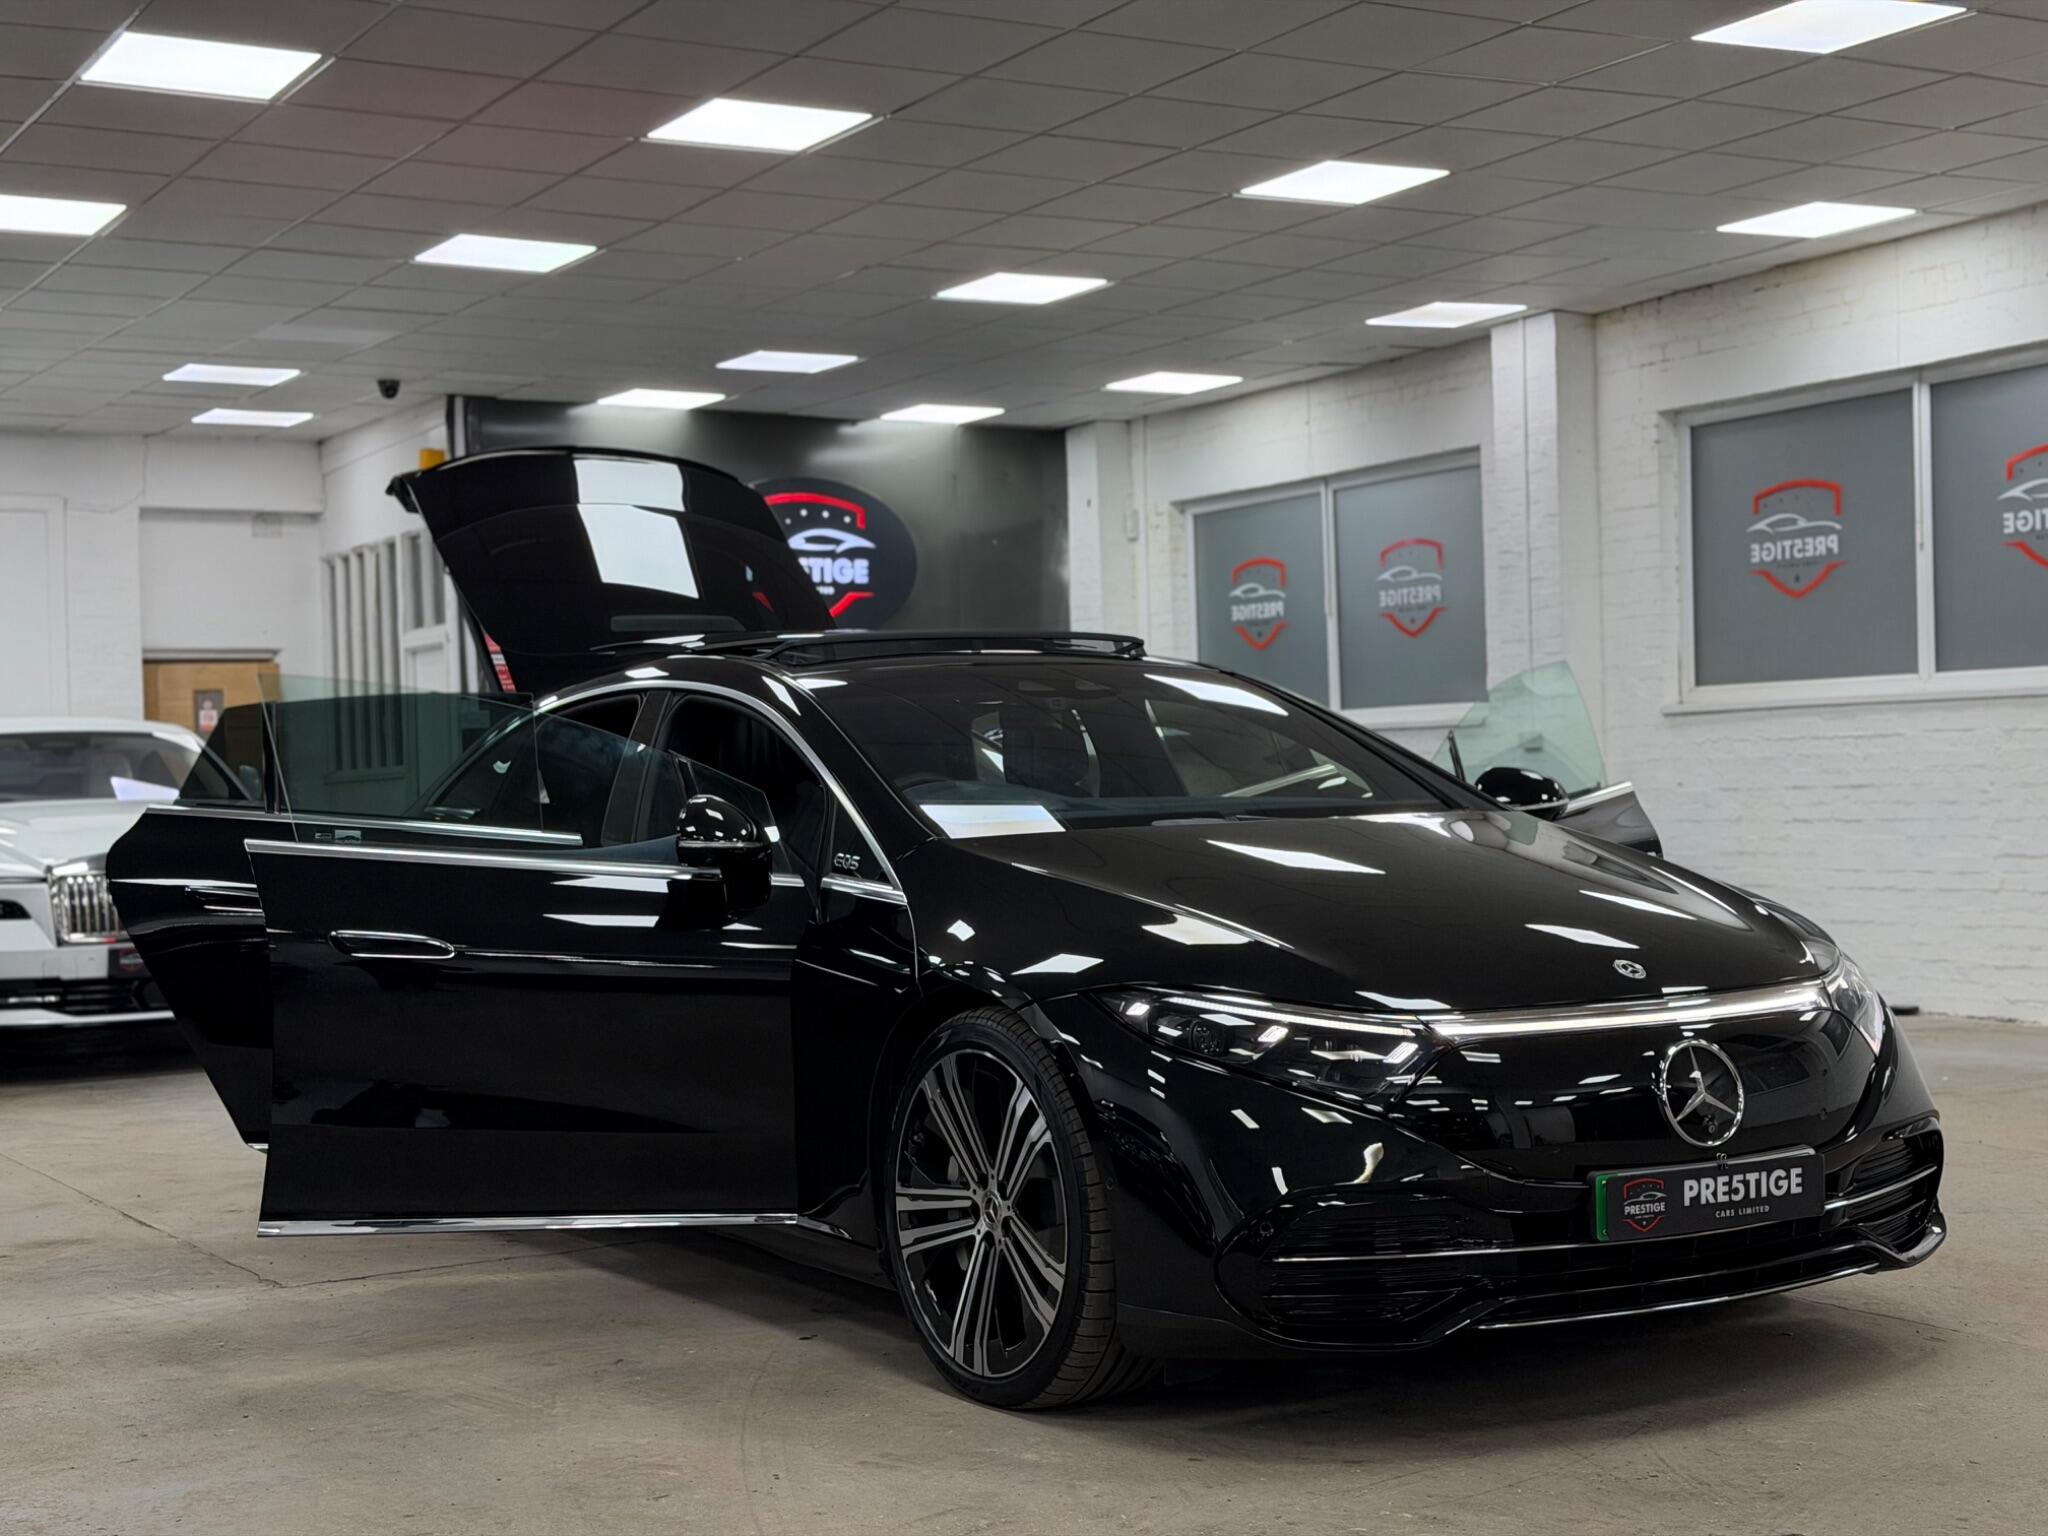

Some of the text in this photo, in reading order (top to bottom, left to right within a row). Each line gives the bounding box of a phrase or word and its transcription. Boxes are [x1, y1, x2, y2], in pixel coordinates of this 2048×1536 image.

[1683, 1168, 1803, 1207] PRESTIGE
[1624, 1202, 1666, 1215] PRESTIGE
[1715, 1205, 1770, 1218] CARS LIMITED
